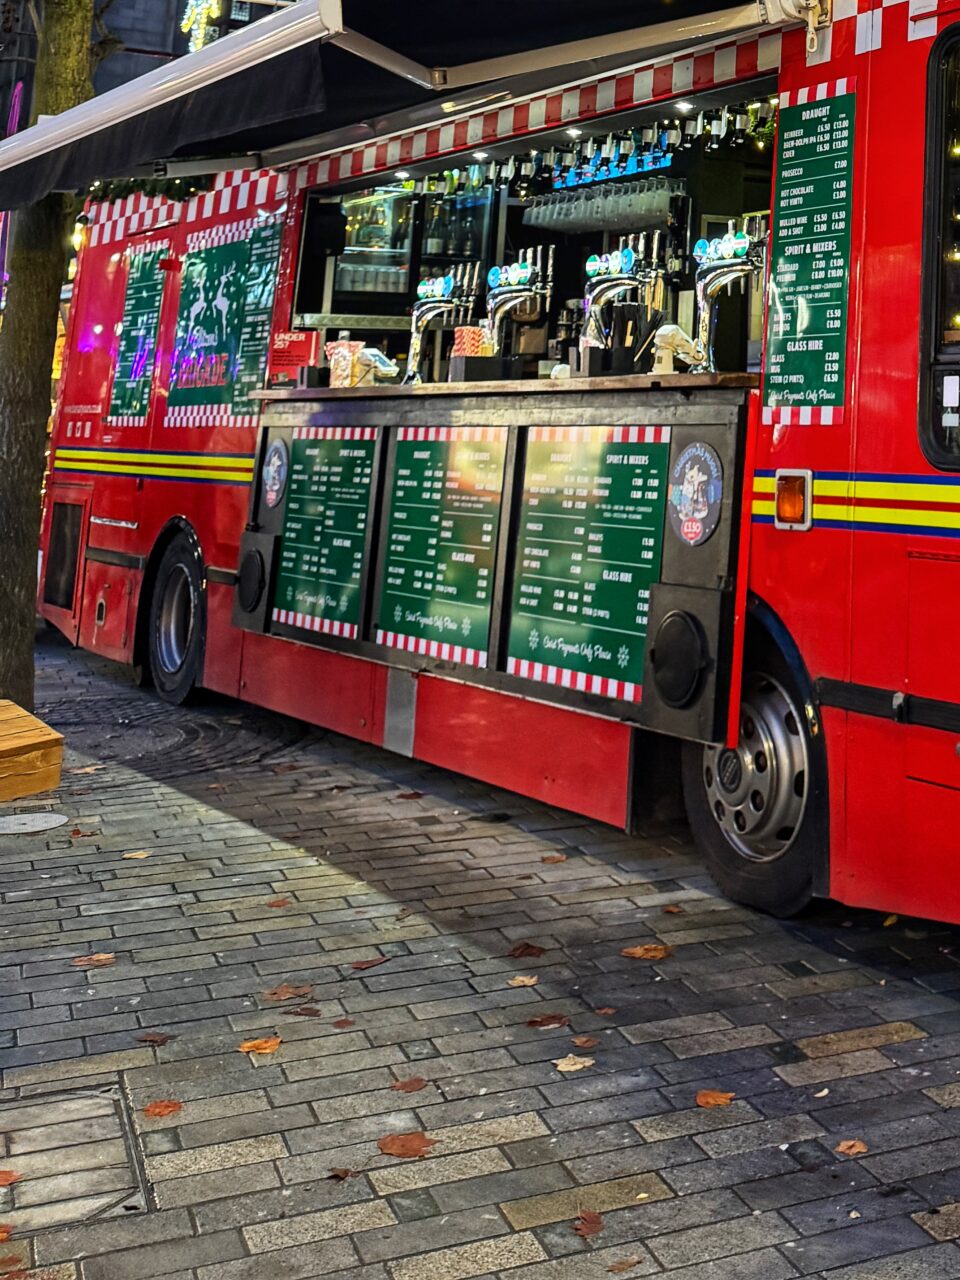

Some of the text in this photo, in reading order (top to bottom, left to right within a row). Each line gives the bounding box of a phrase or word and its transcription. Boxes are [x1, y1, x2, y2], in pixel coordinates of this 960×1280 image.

[802, 105, 831, 120] DRAUGHT
[833, 119, 849, 129] £13.00
[781, 160, 848, 179] PROSECCO £7.00
[781, 180, 847, 198] HOT CHOCOLATE £4.00
[780, 199, 789, 208] HOT
[832, 190, 847, 200] £3.00
[784, 244, 805, 256] SPIRIT
[805, 243, 811, 254] &
[812, 240, 837, 253] MIXERS
[274, 332, 306, 342] UNDER
[786, 339, 824, 352] GLASS HIRE
[771, 354, 785, 363] GLASS
[783, 389, 805, 405] Payments
[805, 389, 818, 405] Only
[818, 389, 836, 400] Please
[602, 569, 632, 583] GLASS HIRE
